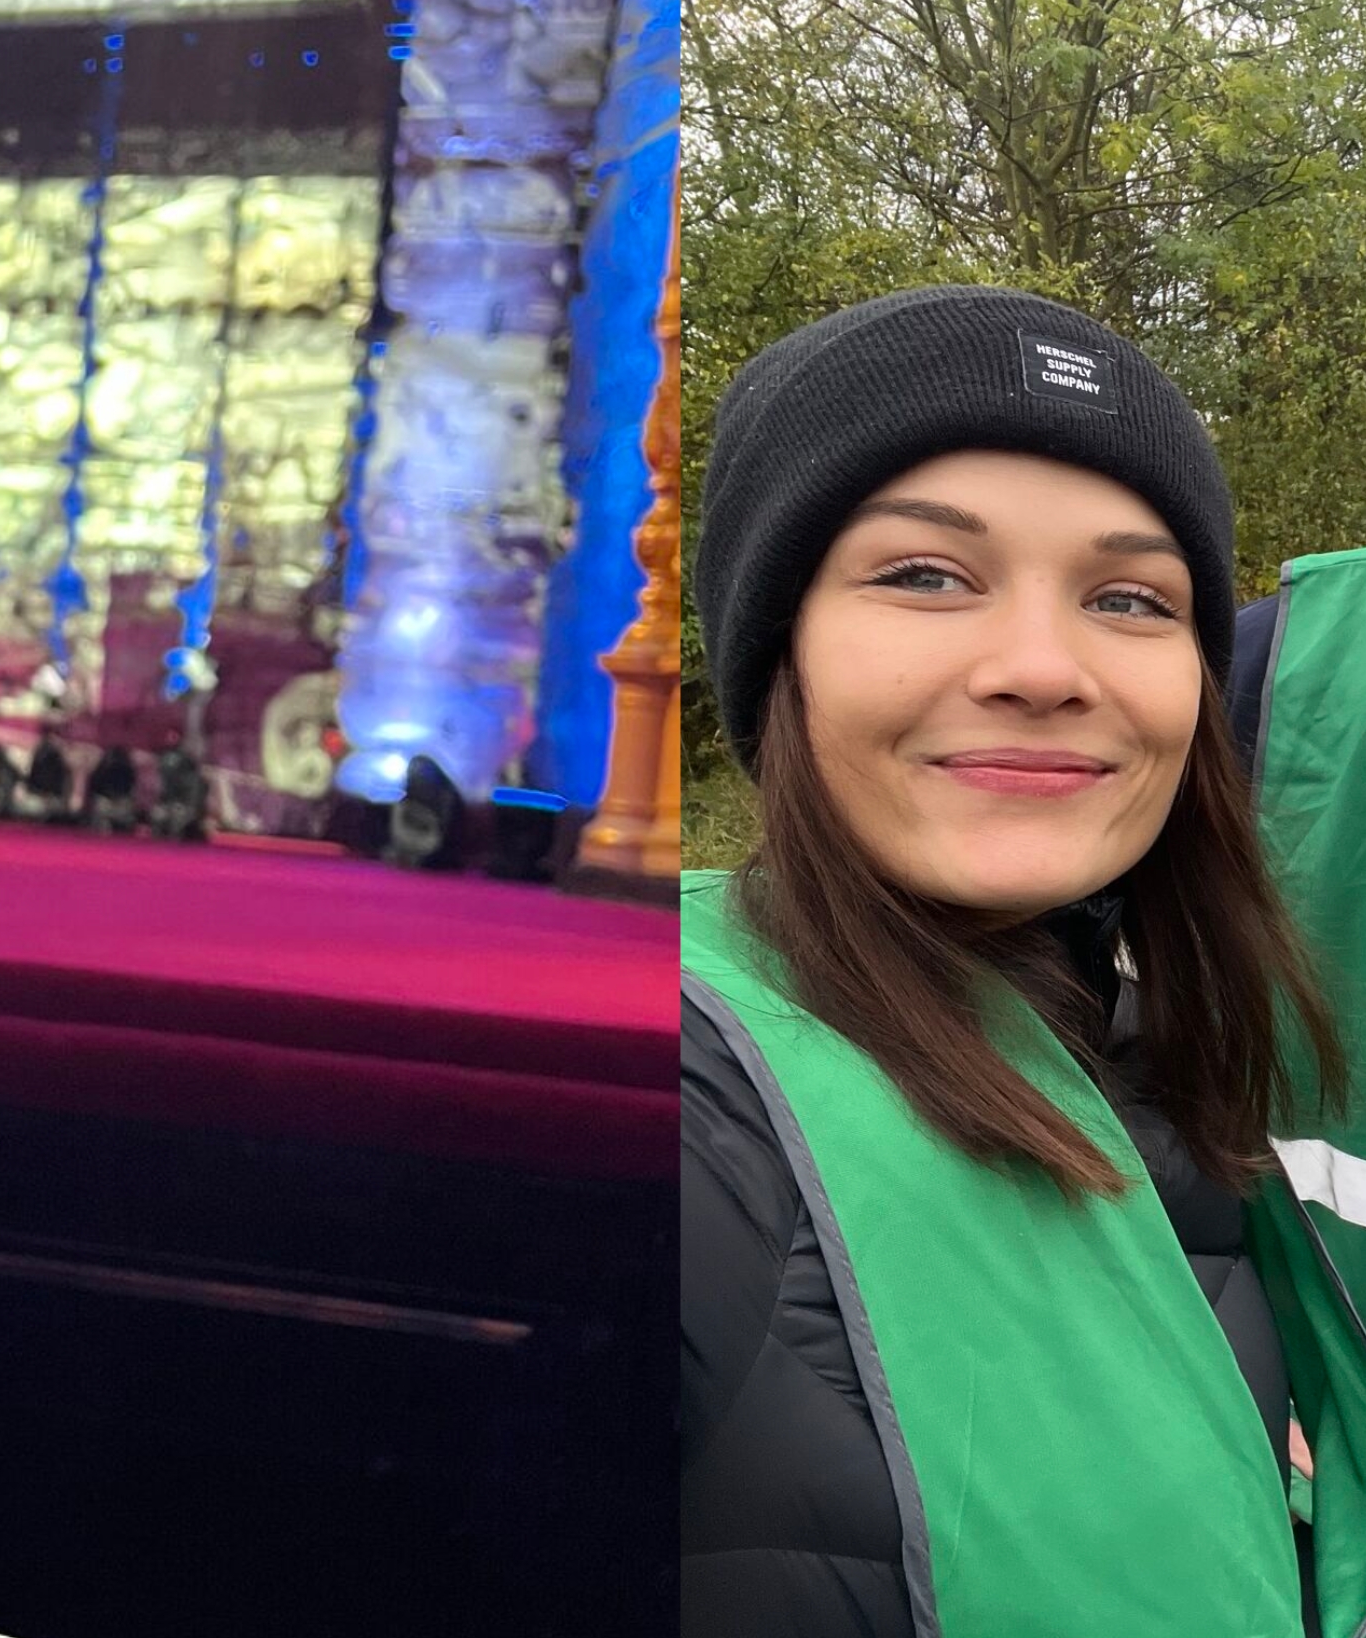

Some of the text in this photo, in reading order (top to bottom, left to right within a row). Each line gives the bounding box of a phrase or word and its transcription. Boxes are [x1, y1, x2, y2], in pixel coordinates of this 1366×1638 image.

[1036, 343, 1097, 368] HERSCHEL
[1046, 358, 1093, 379] SUPPLY
[1041, 371, 1101, 395] COMPANY
